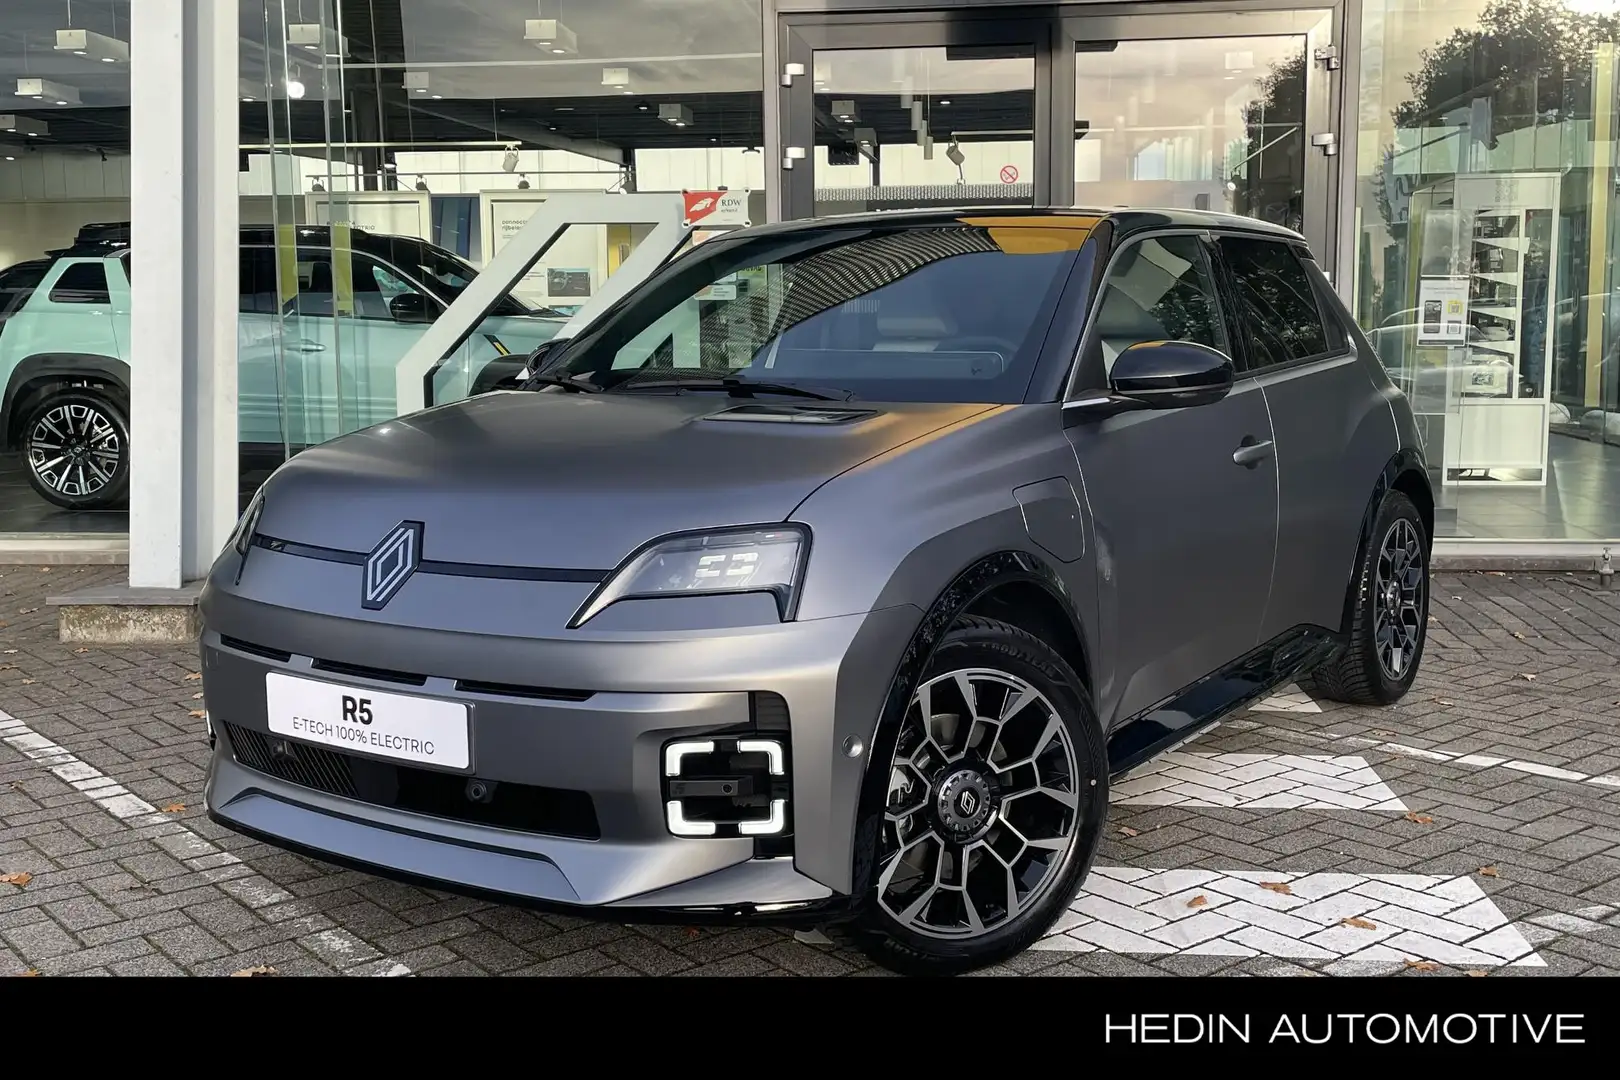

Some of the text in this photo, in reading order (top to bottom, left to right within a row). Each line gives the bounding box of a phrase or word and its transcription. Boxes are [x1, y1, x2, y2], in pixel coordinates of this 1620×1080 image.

[721, 199, 742, 207] RDW
[341, 694, 374, 726] R5
[292, 716, 435, 755] E-TECH 100% ELECTRIC
